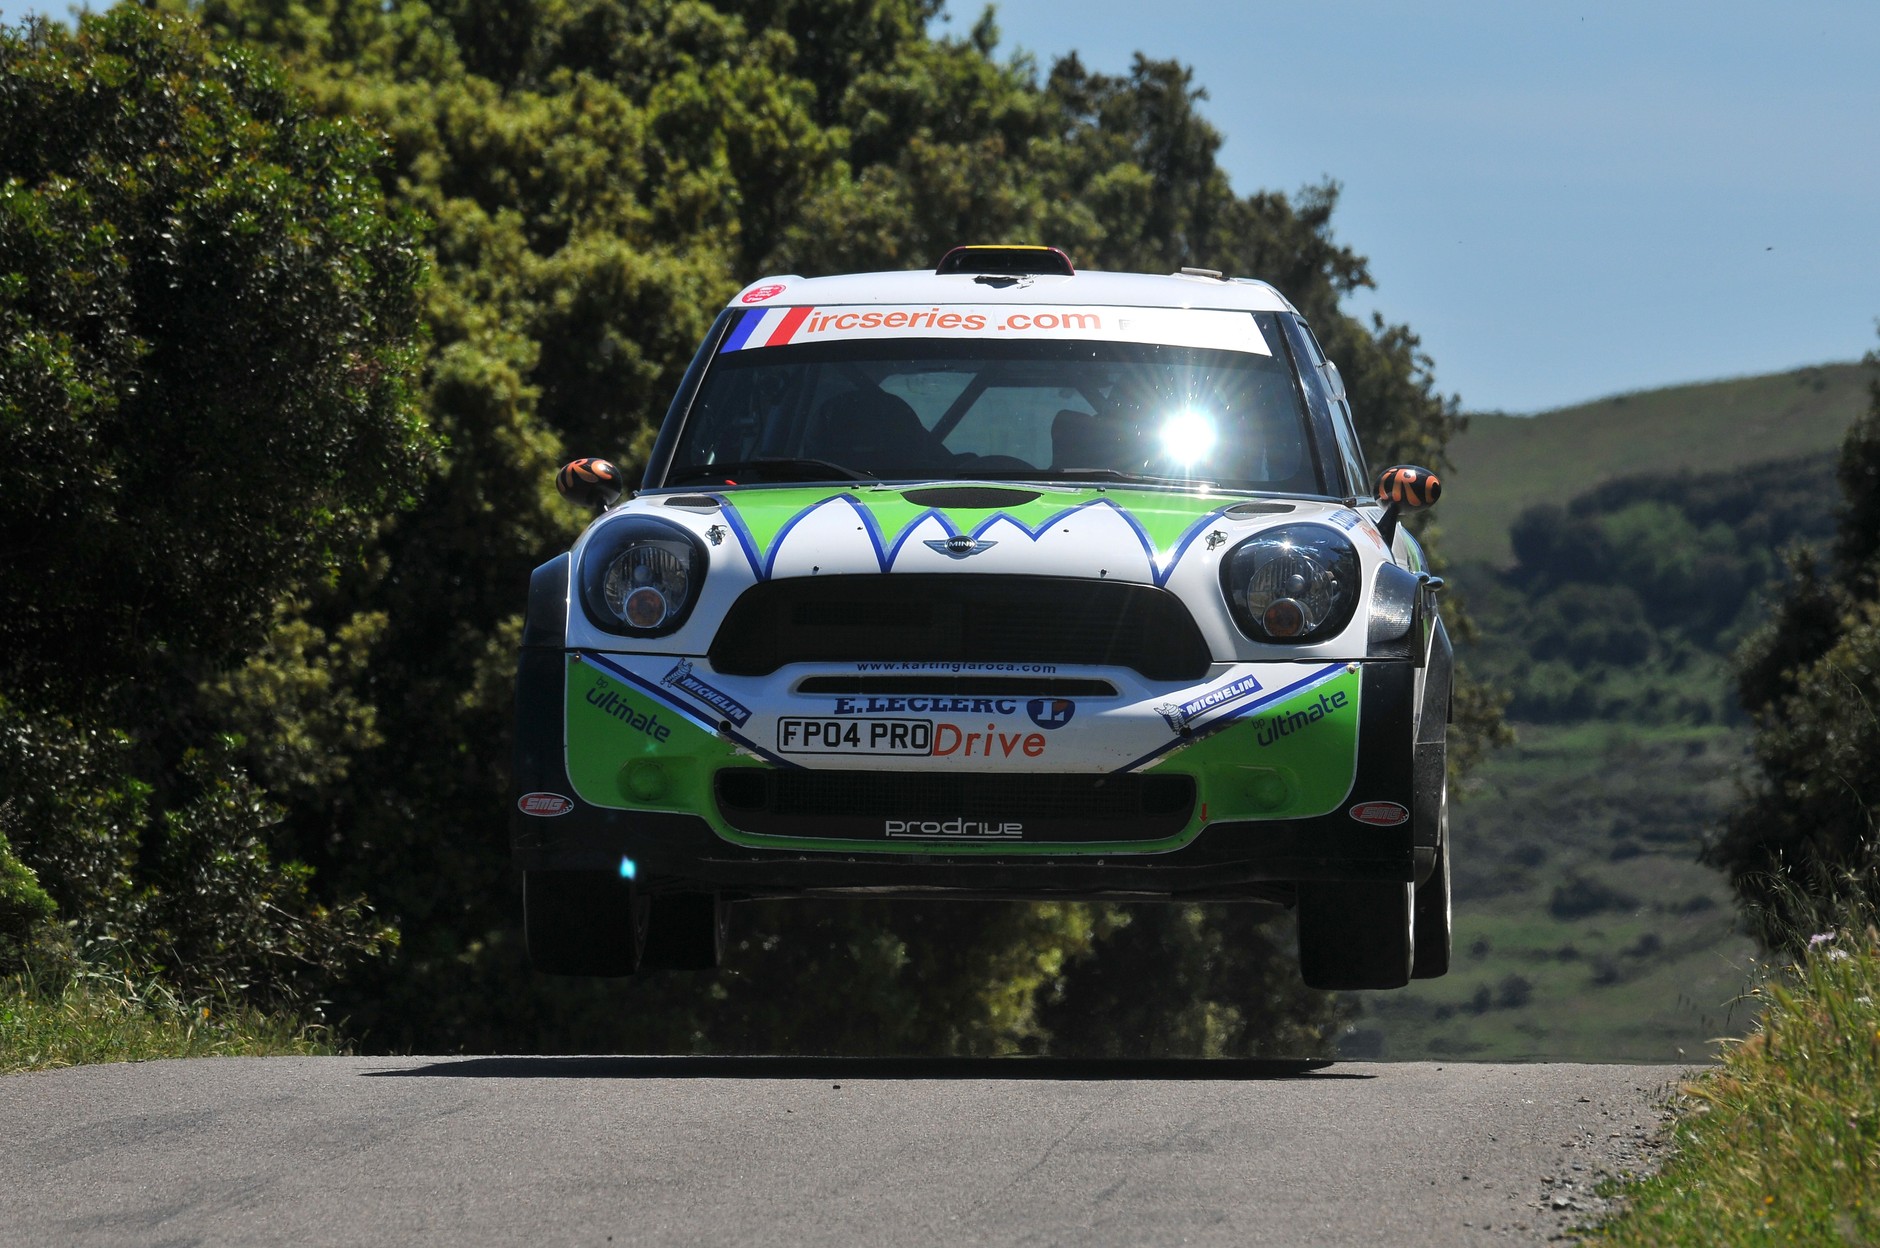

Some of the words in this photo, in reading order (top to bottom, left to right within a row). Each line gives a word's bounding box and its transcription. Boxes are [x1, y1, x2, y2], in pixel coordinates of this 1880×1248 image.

[681, 678, 748, 721] MICHELIN
[834, 697, 1017, 714] E.LECLERC
[1185, 678, 1255, 715] MICHELIN
[586, 688, 671, 743] ultimate
[1257, 691, 1349, 747] ultimate
[783, 721, 861, 748] FP04
[870, 723, 929, 750] PRO
[932, 723, 1046, 758] Drive
[524, 797, 566, 811] SMG
[1359, 806, 1403, 820] SMG
[885, 817, 1023, 837] prodrive
